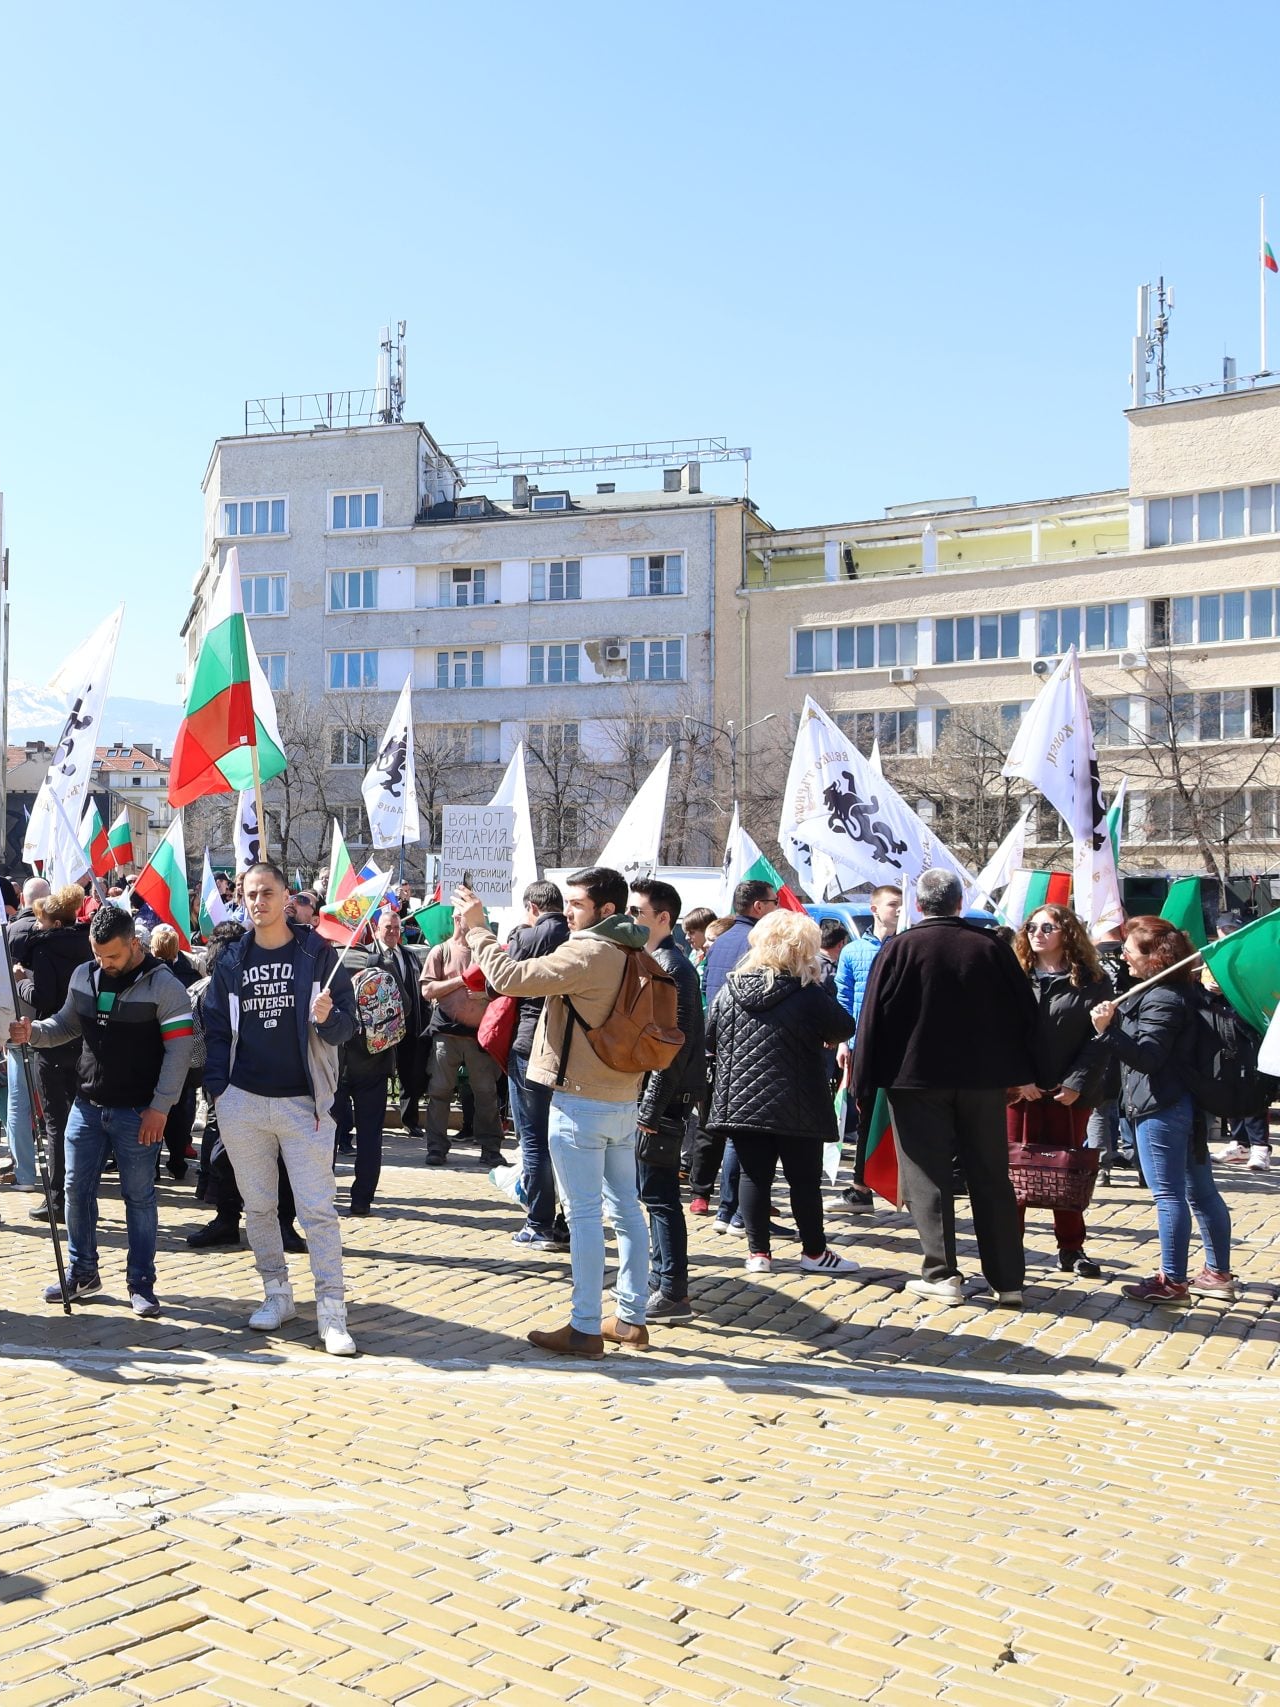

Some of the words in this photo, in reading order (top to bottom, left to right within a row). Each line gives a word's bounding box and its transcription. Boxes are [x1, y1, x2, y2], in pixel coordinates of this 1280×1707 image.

[448, 812, 477, 827] ВЪН
[482, 812, 505, 827] ОТ
[443, 828, 508, 844] БЪЛГАРИЯ
[242, 963, 295, 987] BOSTO
[254, 981, 288, 996] STATE
[242, 995, 295, 1012] UNIVERSIT
